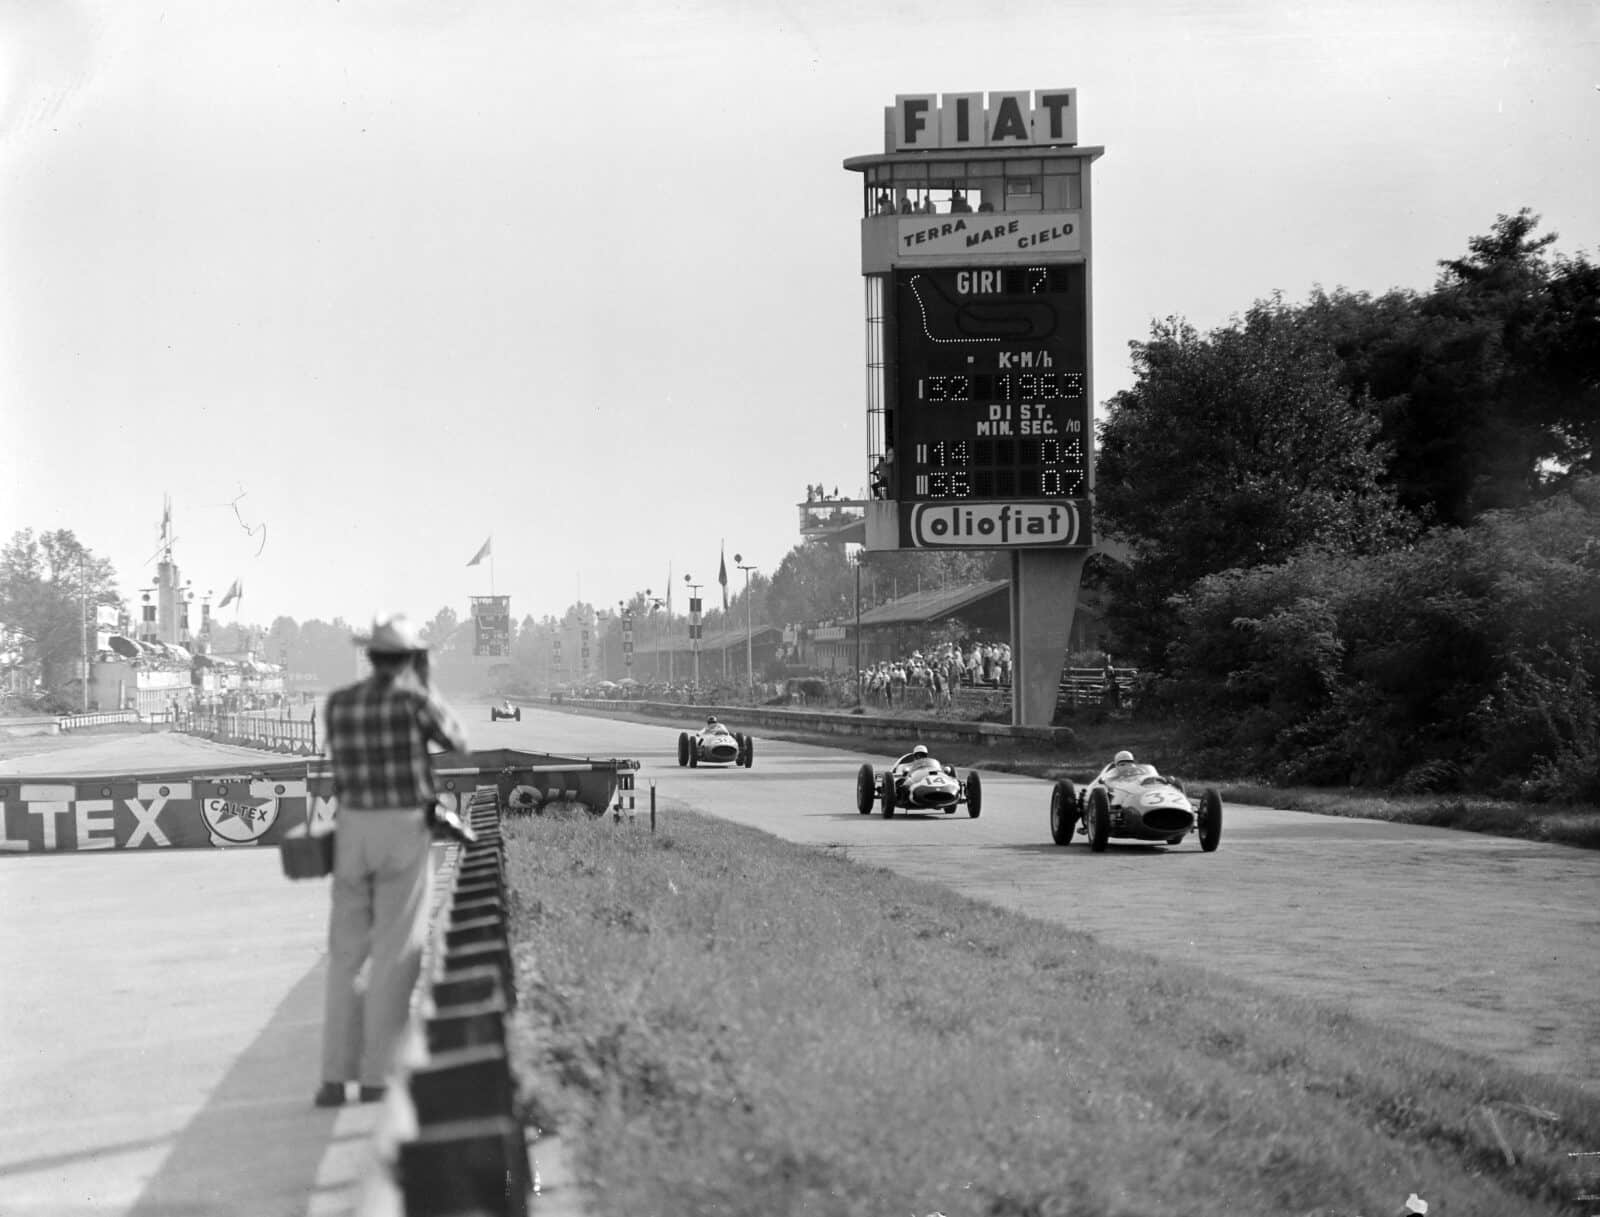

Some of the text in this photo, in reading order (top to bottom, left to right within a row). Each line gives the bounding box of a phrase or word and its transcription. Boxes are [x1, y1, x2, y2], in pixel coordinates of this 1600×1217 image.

[904, 94, 1069, 144] FIAT
[904, 219, 1074, 249] TERRA MARE CIELO
[957, 267, 1047, 294] GIRI 7
[928, 376, 969, 402] 32
[977, 421, 1014, 436] MIN.
[1020, 420, 1058, 435] SEC.
[933, 441, 970, 467] 14
[930, 471, 970, 498] 36
[930, 506, 1061, 543] oliofiat
[925, 776, 946, 786] 14
[210, 800, 268, 822] CALTEX
[1145, 792, 1185, 806] 32
